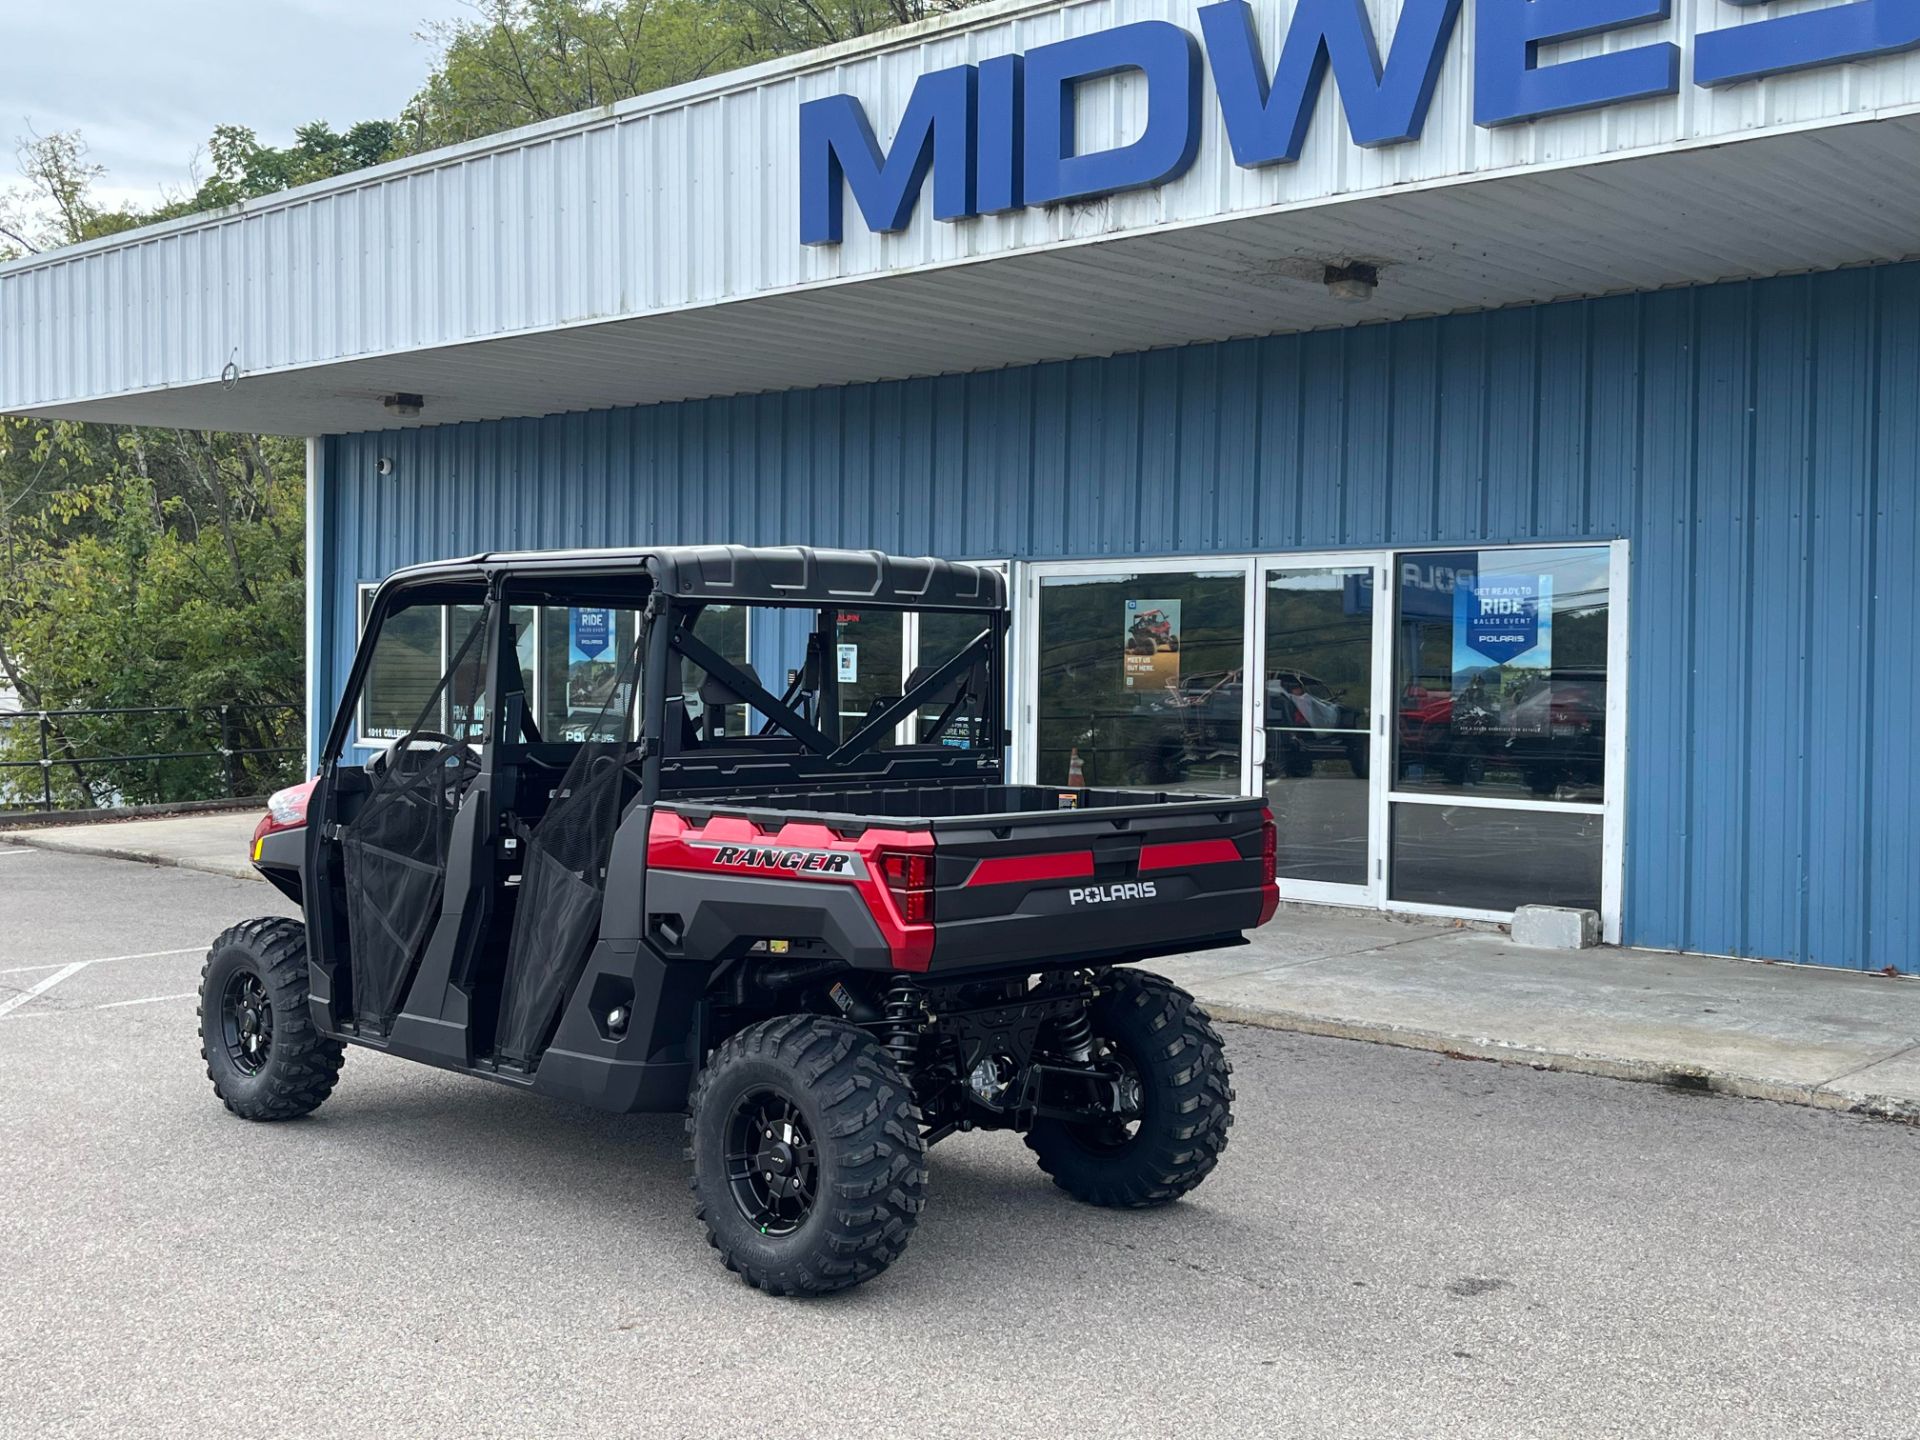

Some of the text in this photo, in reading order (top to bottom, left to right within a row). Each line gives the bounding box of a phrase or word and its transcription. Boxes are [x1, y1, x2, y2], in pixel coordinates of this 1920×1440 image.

[1474, 586, 1532, 596] GET READY TO
[1480, 598, 1524, 616] RIDE
[582, 614, 602, 626] RIDE
[1503, 617, 1531, 625] EVENT
[1478, 635, 1525, 643] POLARIS
[367, 728, 382, 737] 1011
[714, 846, 850, 873] RANGER
[1068, 881, 1157, 906] POLARIS
